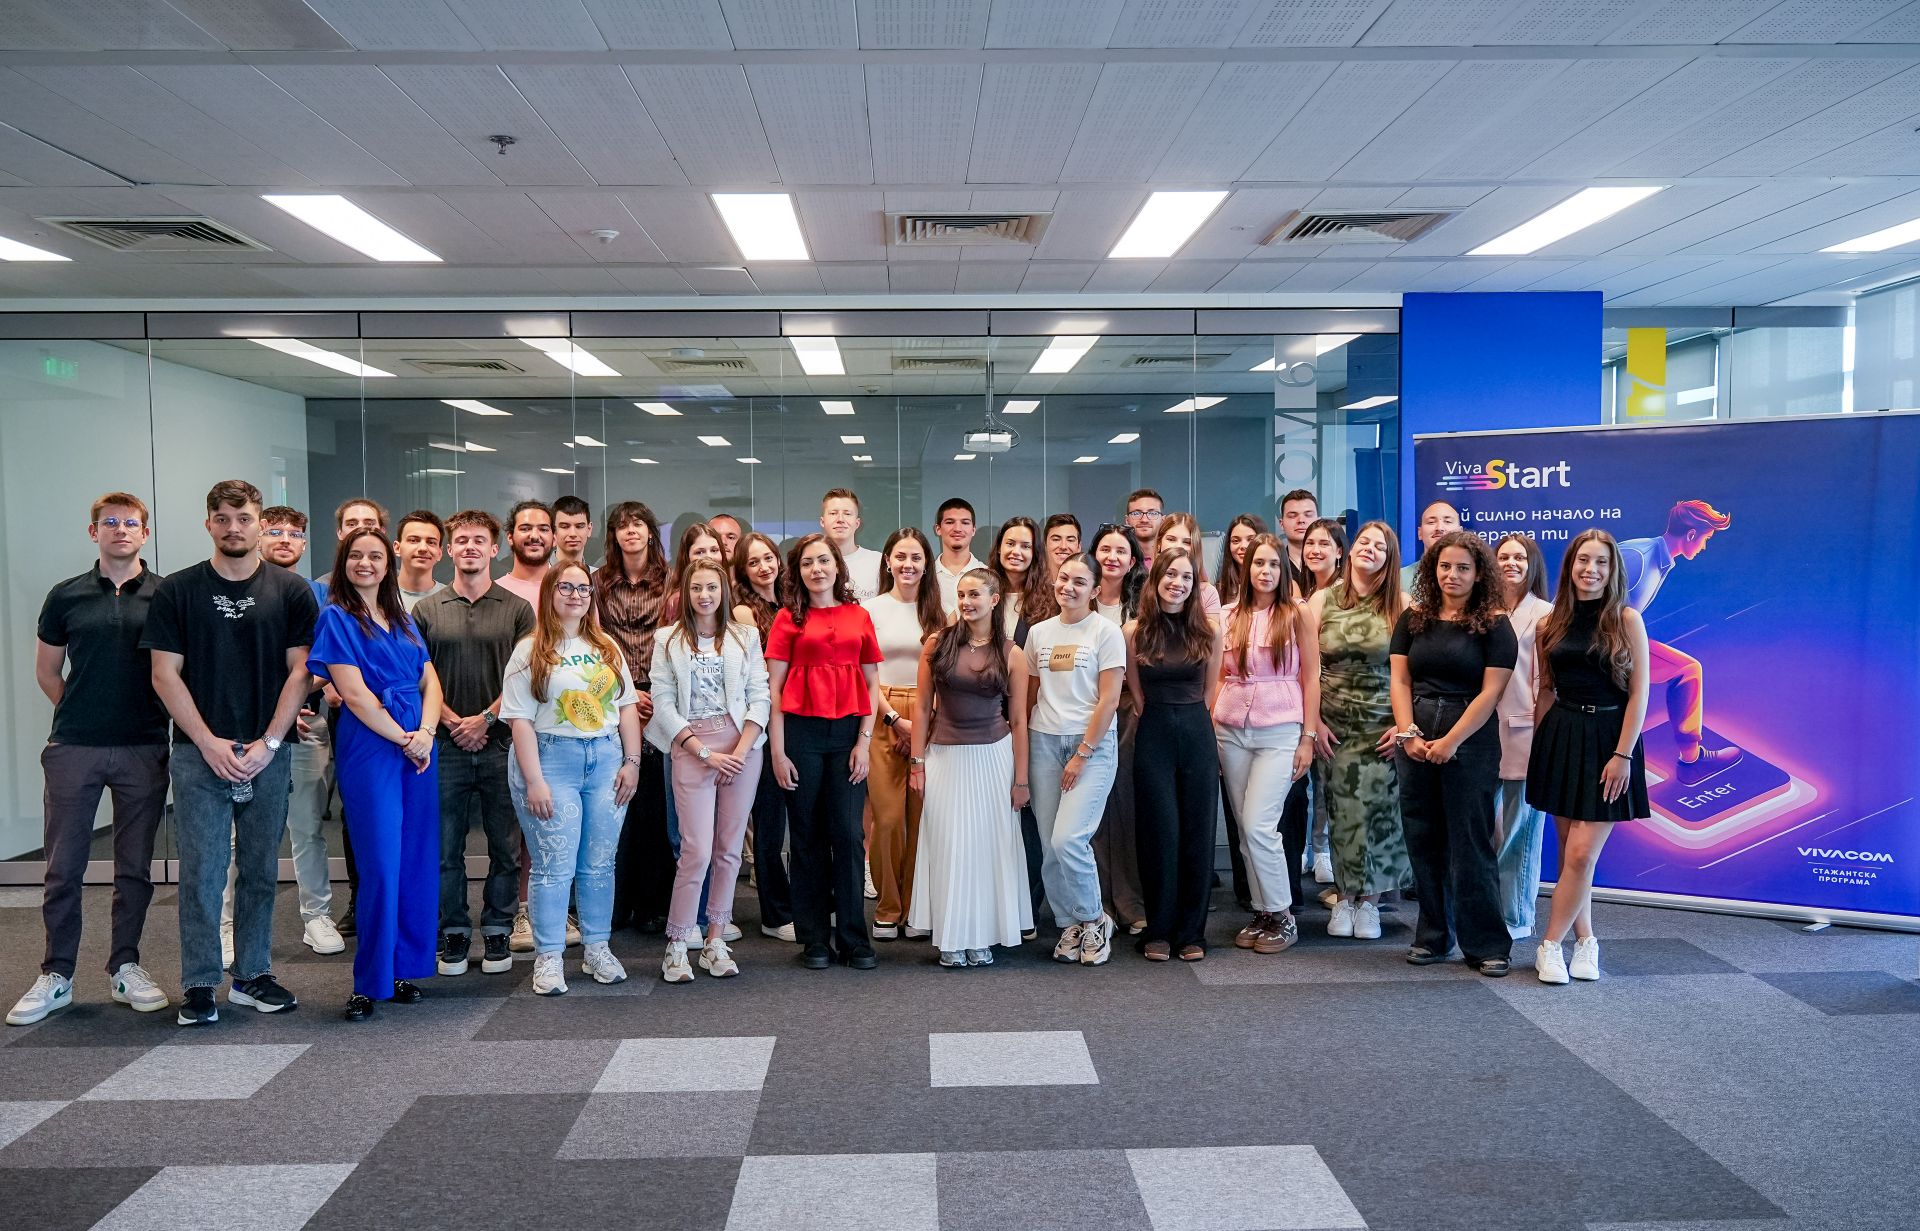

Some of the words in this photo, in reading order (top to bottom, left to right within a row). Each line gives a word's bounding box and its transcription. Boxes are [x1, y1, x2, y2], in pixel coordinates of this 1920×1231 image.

[1275, 361, 1318, 388] 6
[1445, 461, 1482, 475] Viva
[1485, 459, 1571, 490] Start
[1475, 510, 1526, 522] силно
[1531, 508, 1595, 521] начало
[1600, 507, 1622, 519] на
[1541, 529, 1568, 540] ти
[1676, 782, 1738, 809] Enter
[1797, 846, 1894, 863] VIVACOM
[1812, 867, 1877, 879] СТАЖАНТСКА
[1818, 875, 1870, 886] ПРОГРАМА
